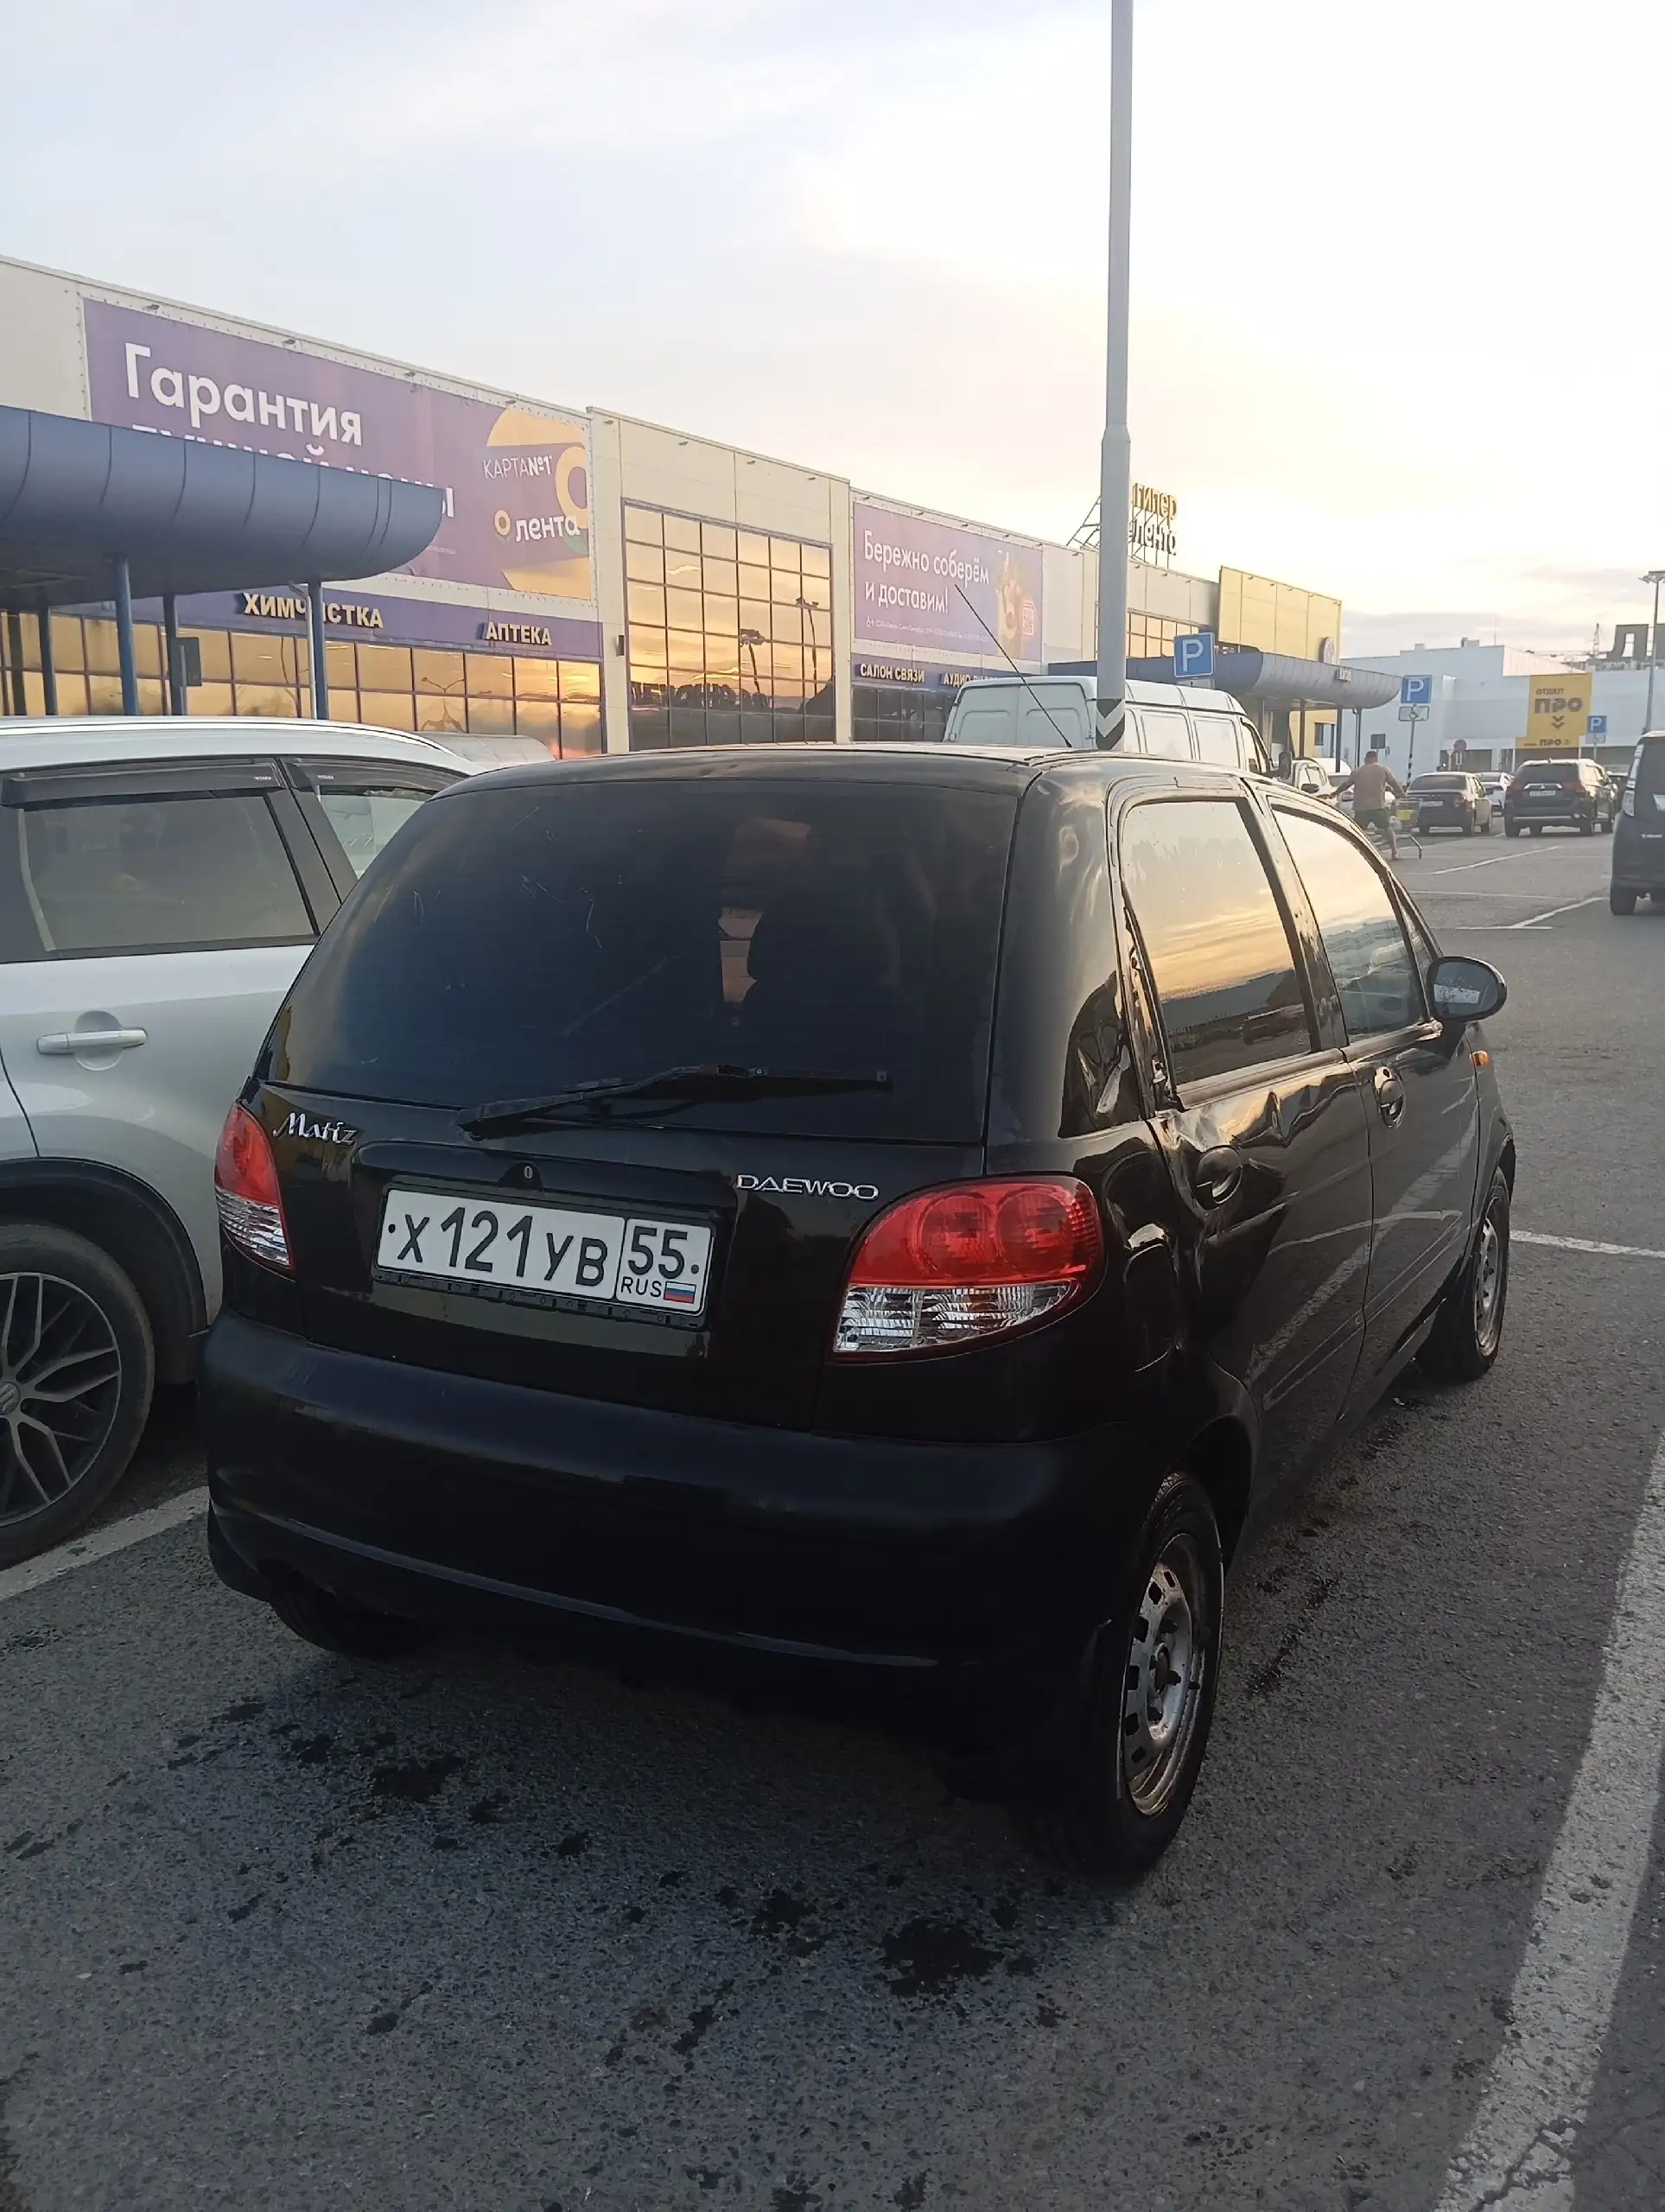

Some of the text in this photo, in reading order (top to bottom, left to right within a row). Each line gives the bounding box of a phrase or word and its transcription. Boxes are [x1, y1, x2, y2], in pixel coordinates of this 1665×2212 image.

[125, 342, 362, 446] Гарантия
[515, 516, 581, 542] лента
[864, 530, 989, 588] Бережно соберём
[243, 592, 384, 629] ХИМЧСТКА
[865, 582, 948, 614] и доставим!
[484, 622, 552, 645] АПТЕКА
[1183, 639, 1204, 671] P
[861, 663, 925, 683] САЛОН СВЯЗИ
[1407, 679, 1424, 701] P
[1535, 698, 1583, 713] ПРО
[1591, 717, 1602, 731] P
[273, 1112, 358, 1145] Matiz
[736, 1174, 879, 1199] DAEWOO
[627, 1226, 689, 1280] 55
[620, 1276, 662, 1298] RUS
